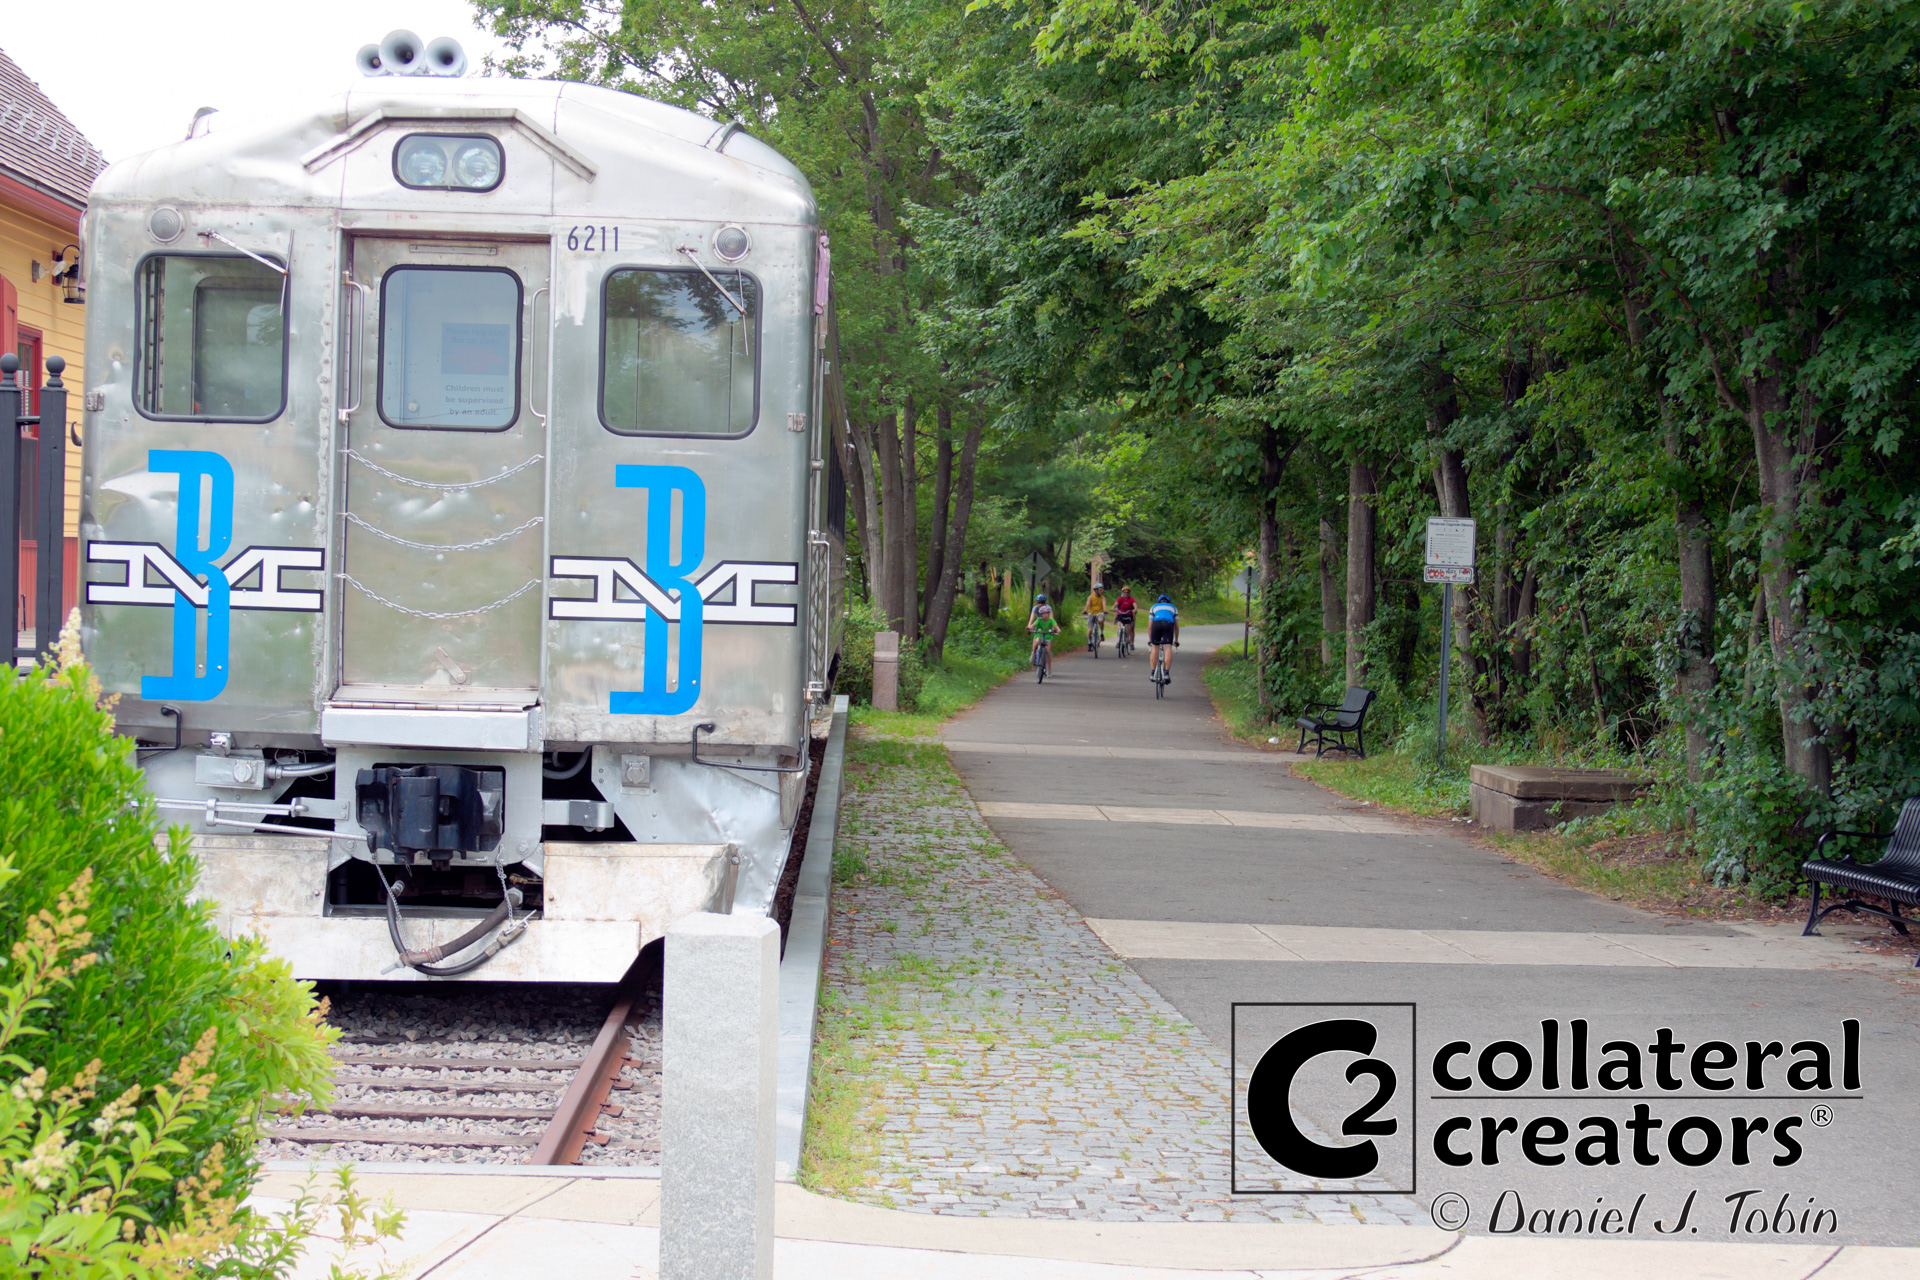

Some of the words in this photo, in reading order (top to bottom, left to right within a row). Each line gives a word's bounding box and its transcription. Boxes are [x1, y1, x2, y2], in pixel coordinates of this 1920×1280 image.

[567, 225, 619, 252] 6211
[445, 384, 480, 392] Children
[458, 396, 504, 404] supervised
[449, 408, 459, 416] by
